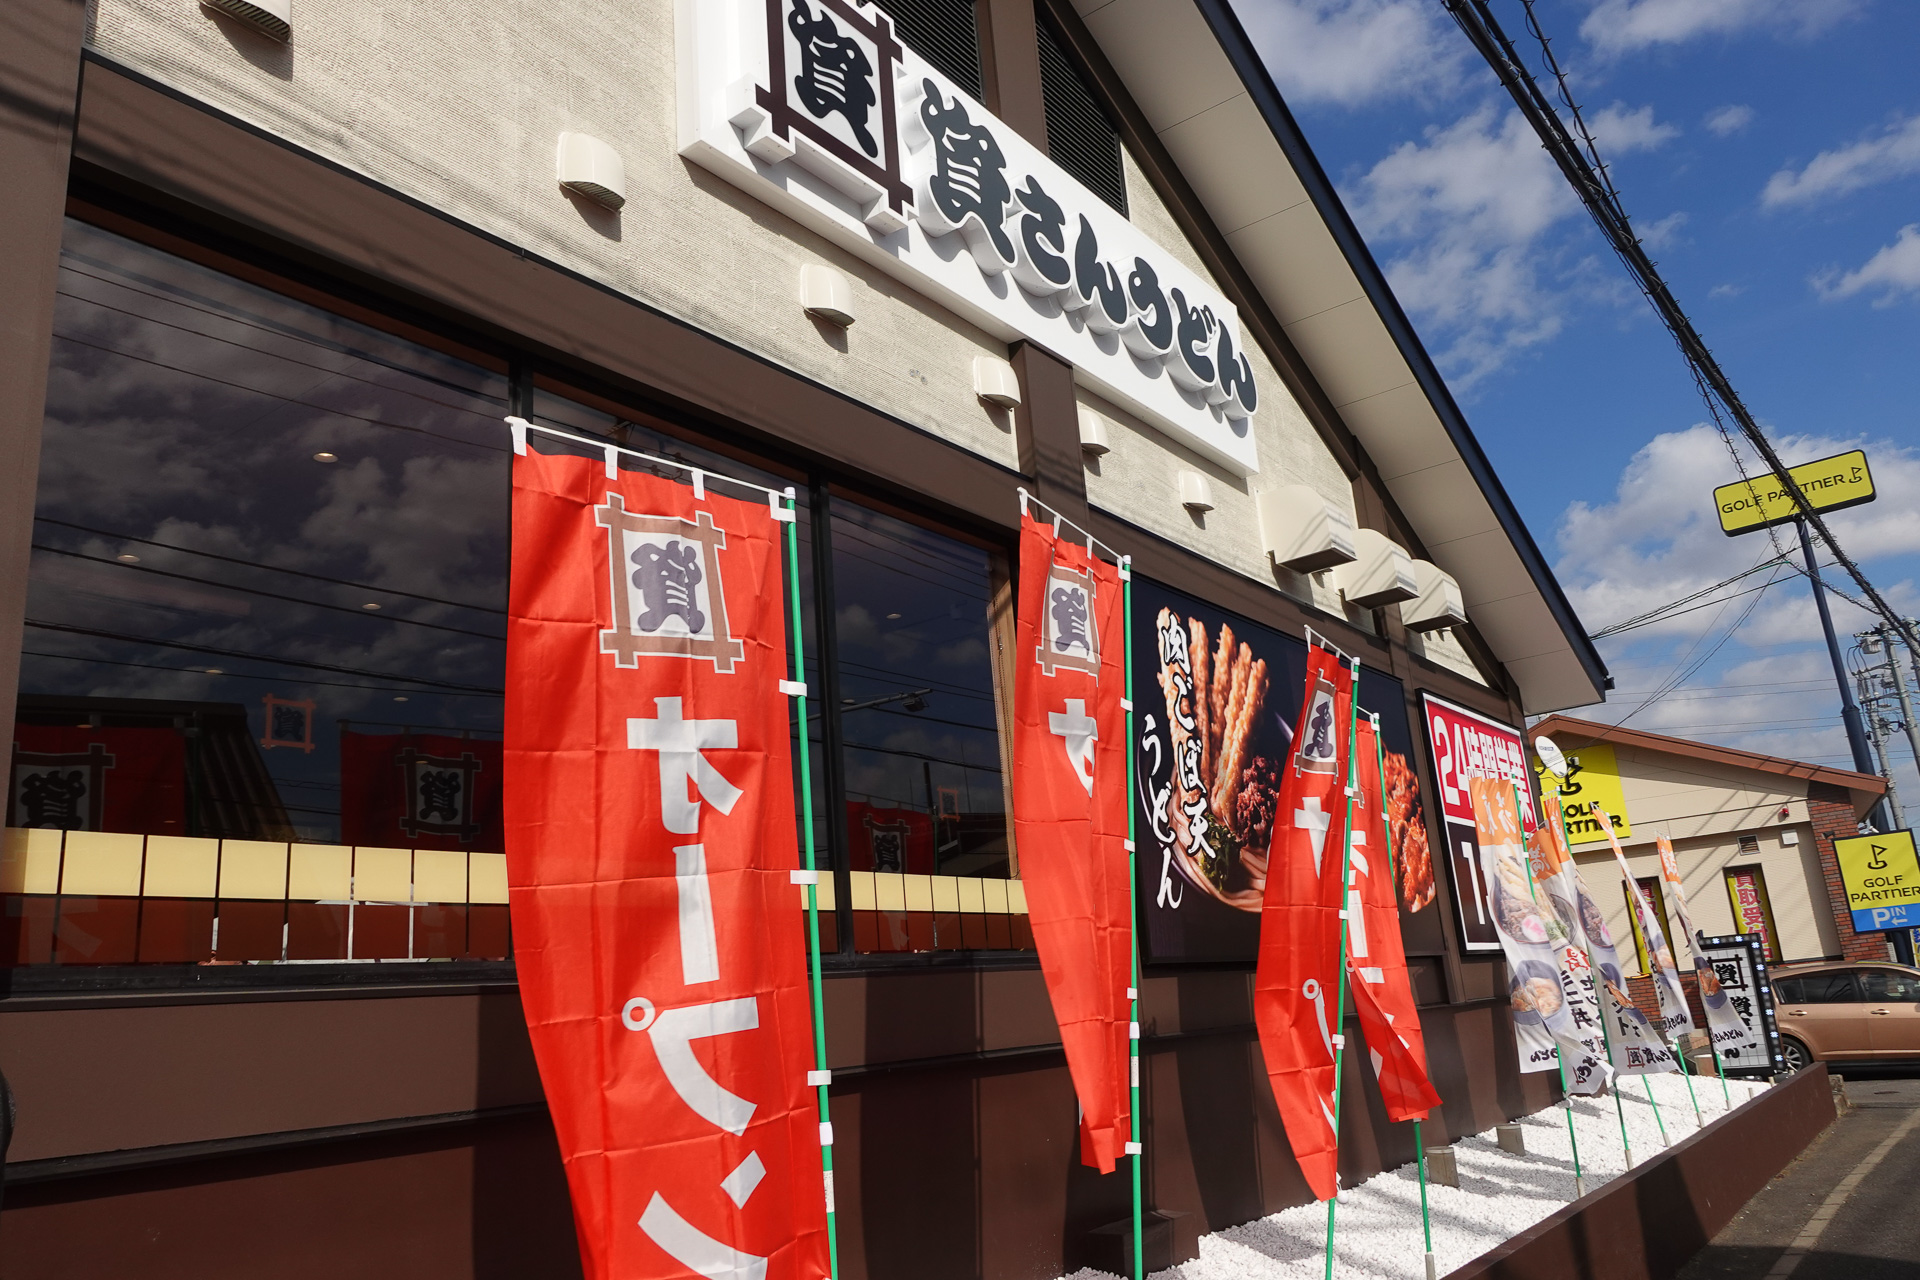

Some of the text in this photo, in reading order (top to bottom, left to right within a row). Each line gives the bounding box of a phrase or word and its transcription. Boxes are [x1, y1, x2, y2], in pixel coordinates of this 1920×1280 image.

[920, 77, 1258, 415] 資さんうどん
[1722, 474, 1845, 514] GOLF PATNER
[1159, 612, 1216, 859] 肉ごぼ天
[1140, 713, 1183, 909] うどん
[1562, 801, 1599, 818] OLF
[1850, 886, 1920, 903] PARTNER
[1863, 875, 1903, 888] GOLF
[1872, 906, 1907, 928] P IN
